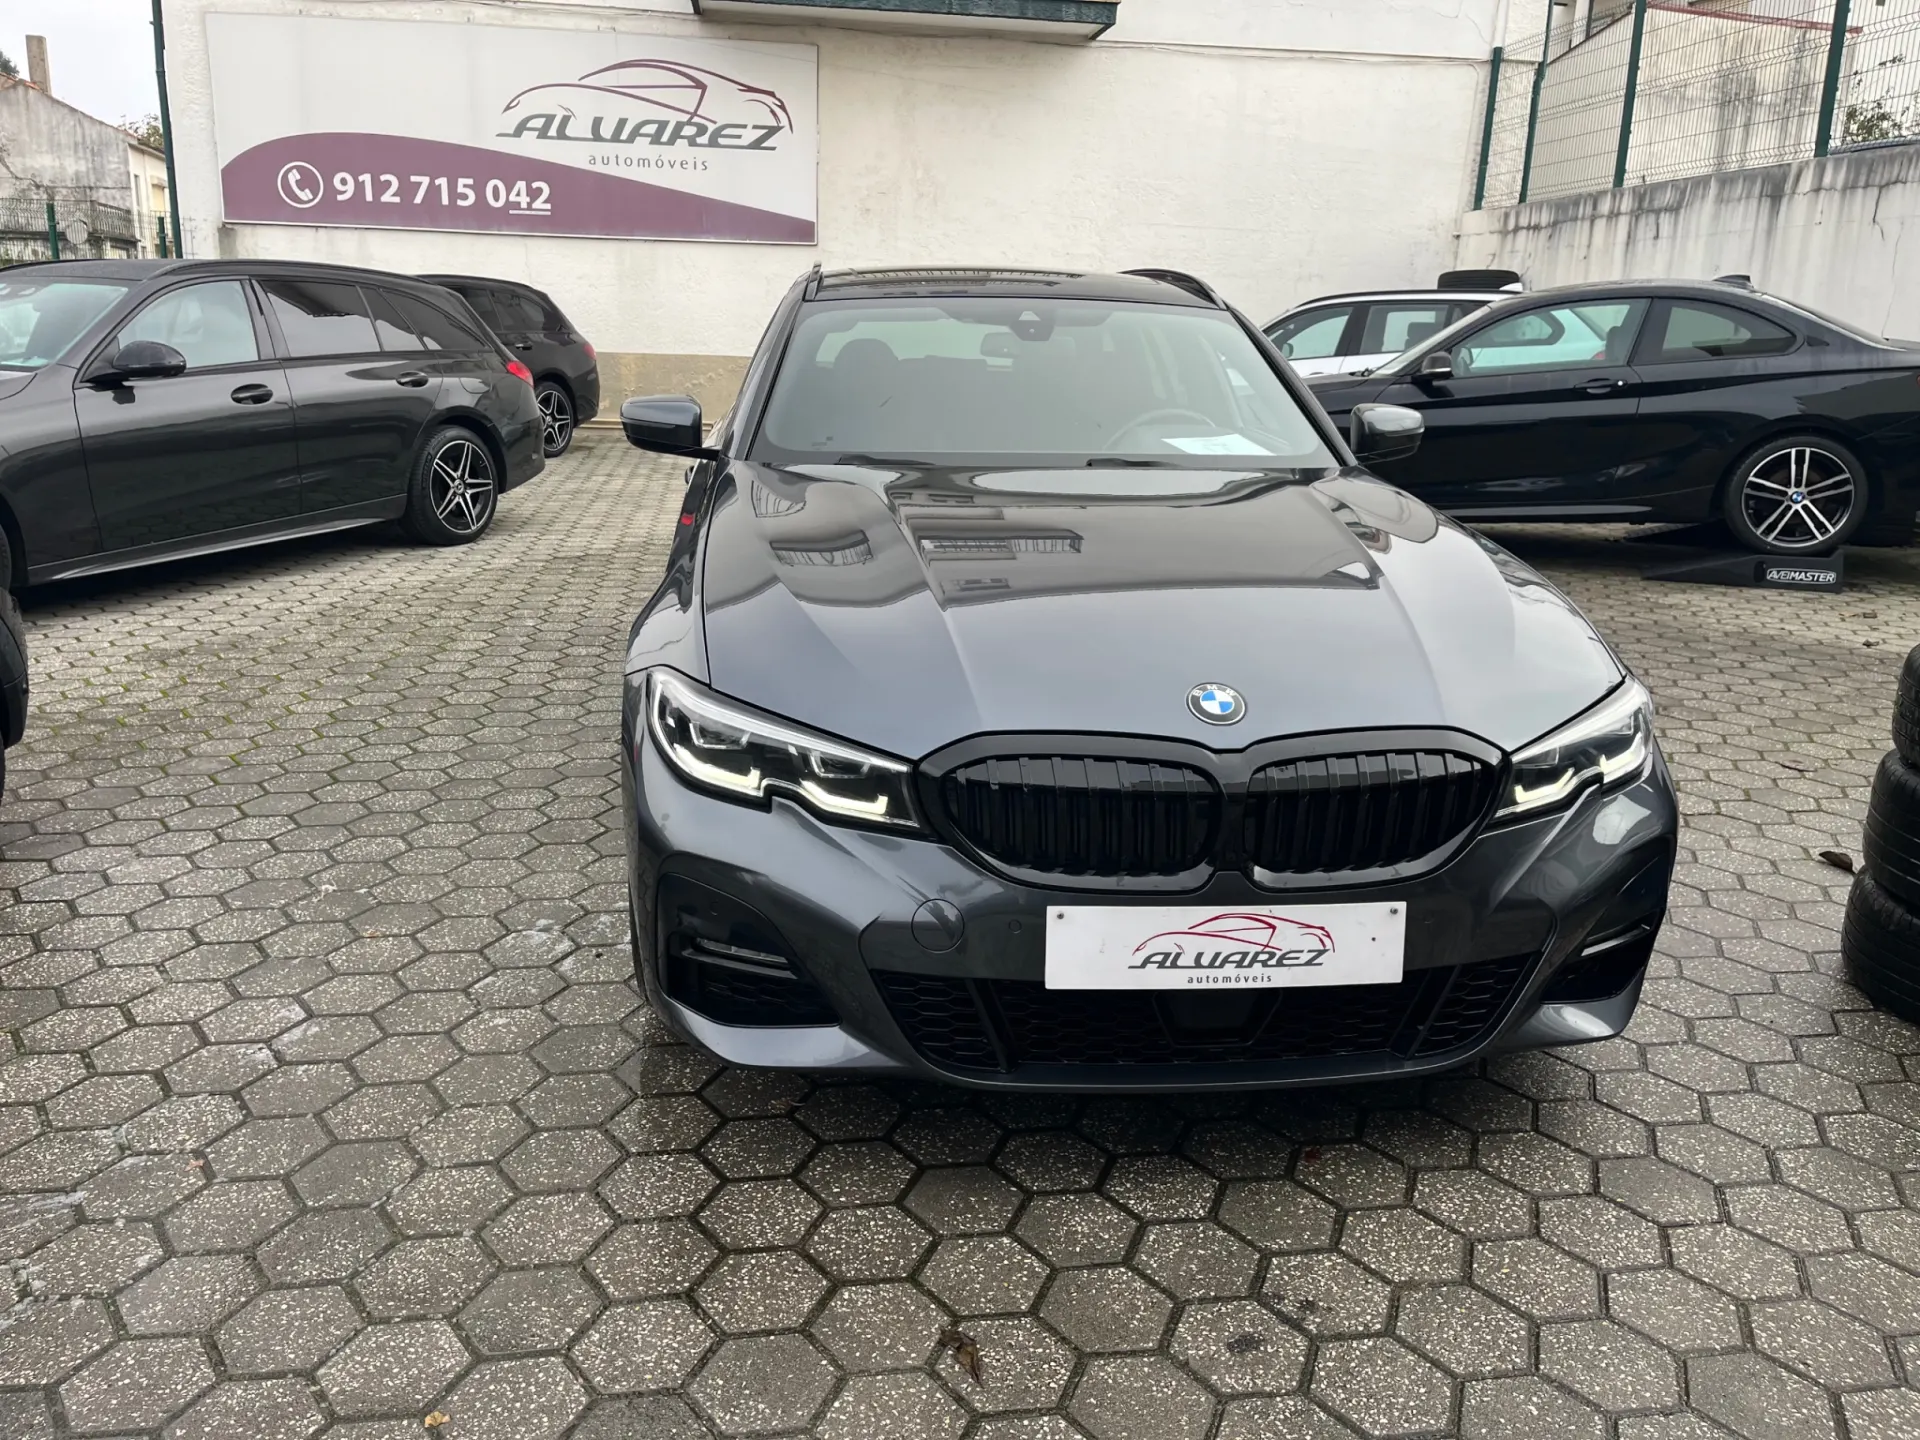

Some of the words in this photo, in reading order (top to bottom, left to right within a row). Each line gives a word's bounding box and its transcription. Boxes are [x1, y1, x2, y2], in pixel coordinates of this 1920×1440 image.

[495, 112, 785, 151] ALVAREZ
[588, 152, 709, 171] automóveis
[333, 171, 401, 203] 912
[410, 175, 476, 207] 715
[485, 178, 552, 210] 042
[1192, 684, 1237, 697] BMW
[1128, 948, 1331, 969] ALVAREZ
[1187, 973, 1272, 984] automóveis
